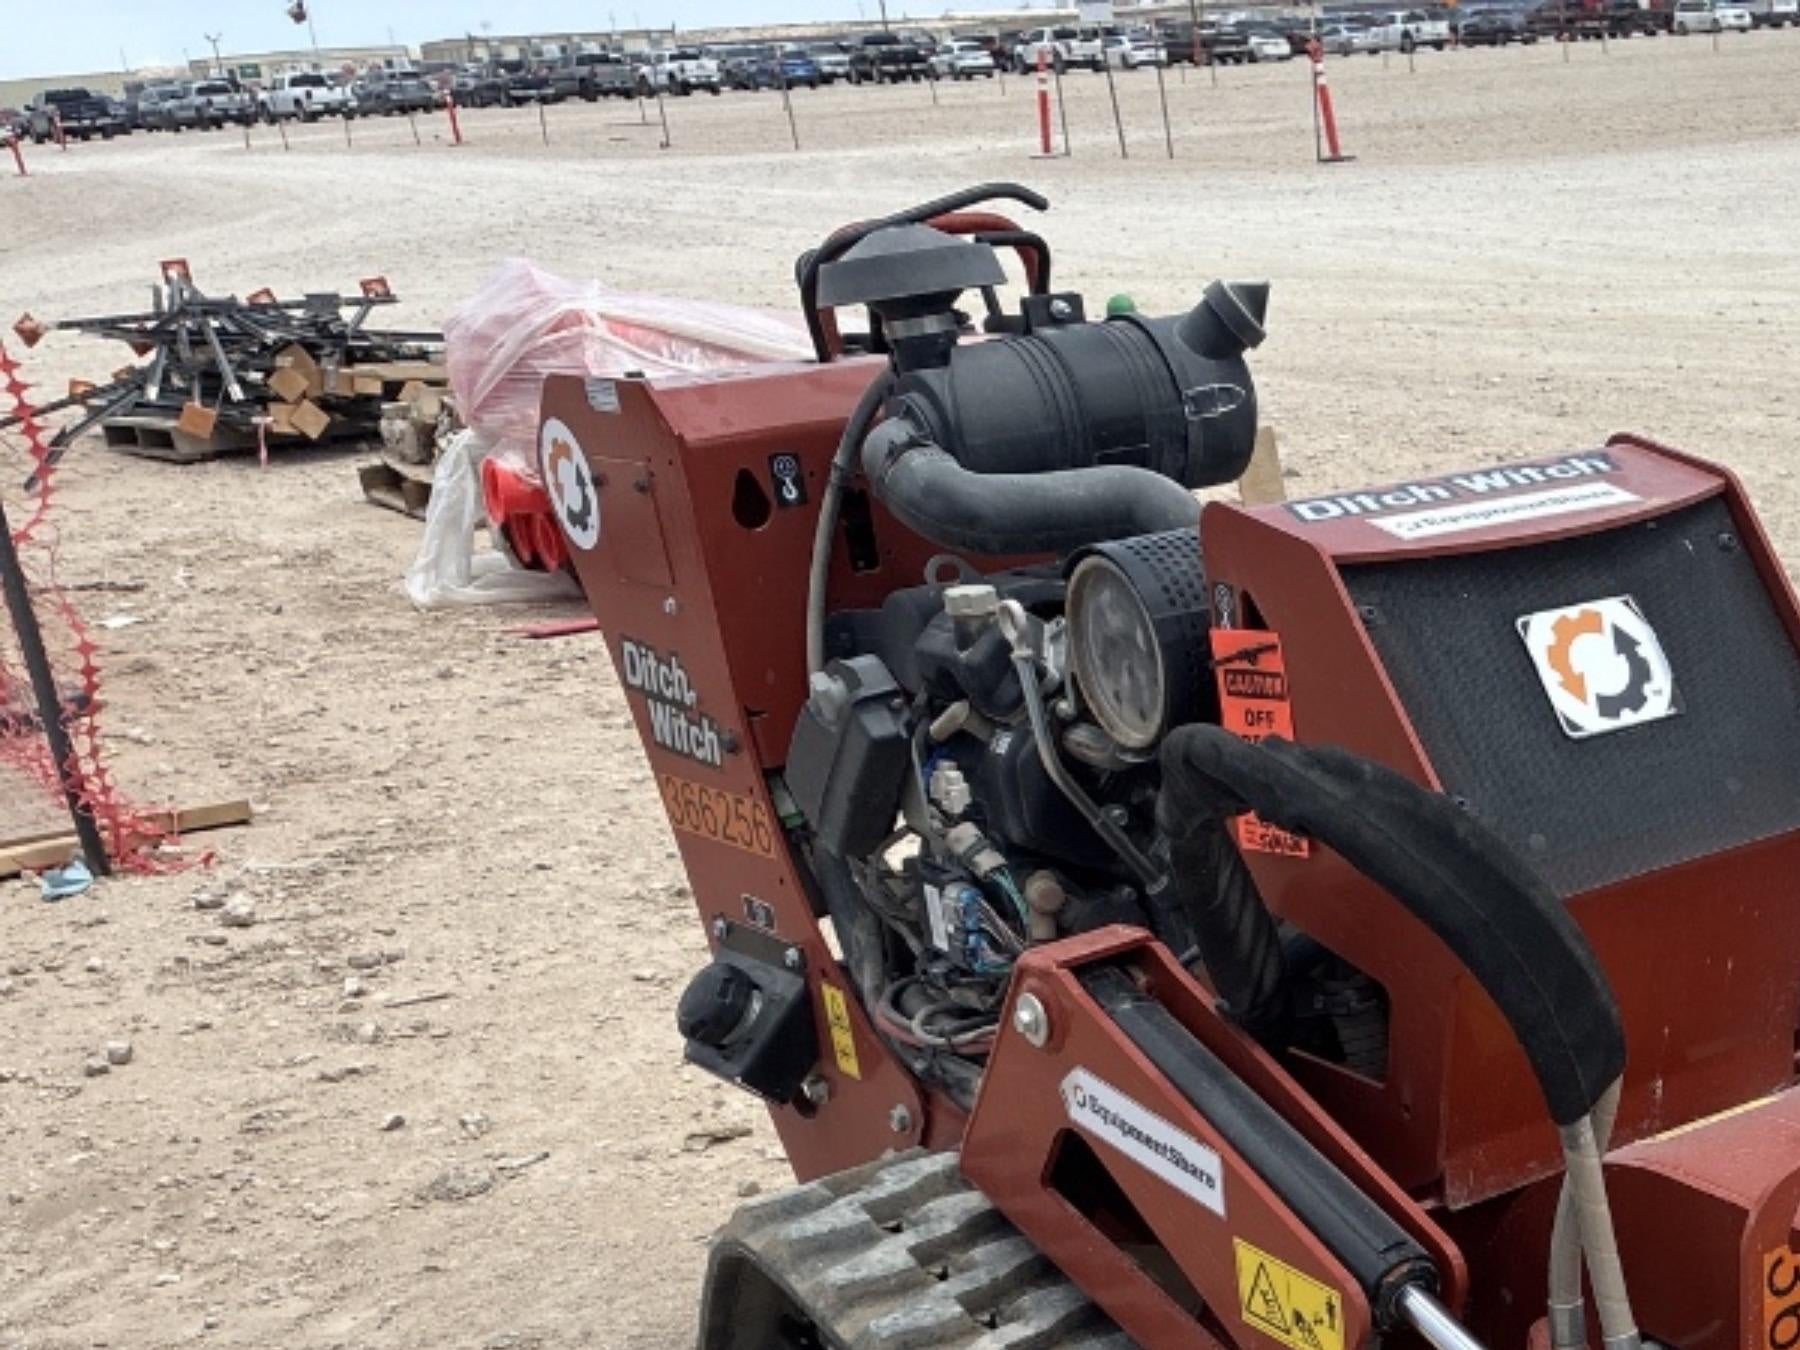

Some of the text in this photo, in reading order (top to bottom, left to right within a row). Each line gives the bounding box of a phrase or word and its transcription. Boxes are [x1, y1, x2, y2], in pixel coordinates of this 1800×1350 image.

[1292, 455, 1613, 522] Ditch Witch
[648, 697, 722, 767] Witch
[664, 774, 773, 854] 366256
